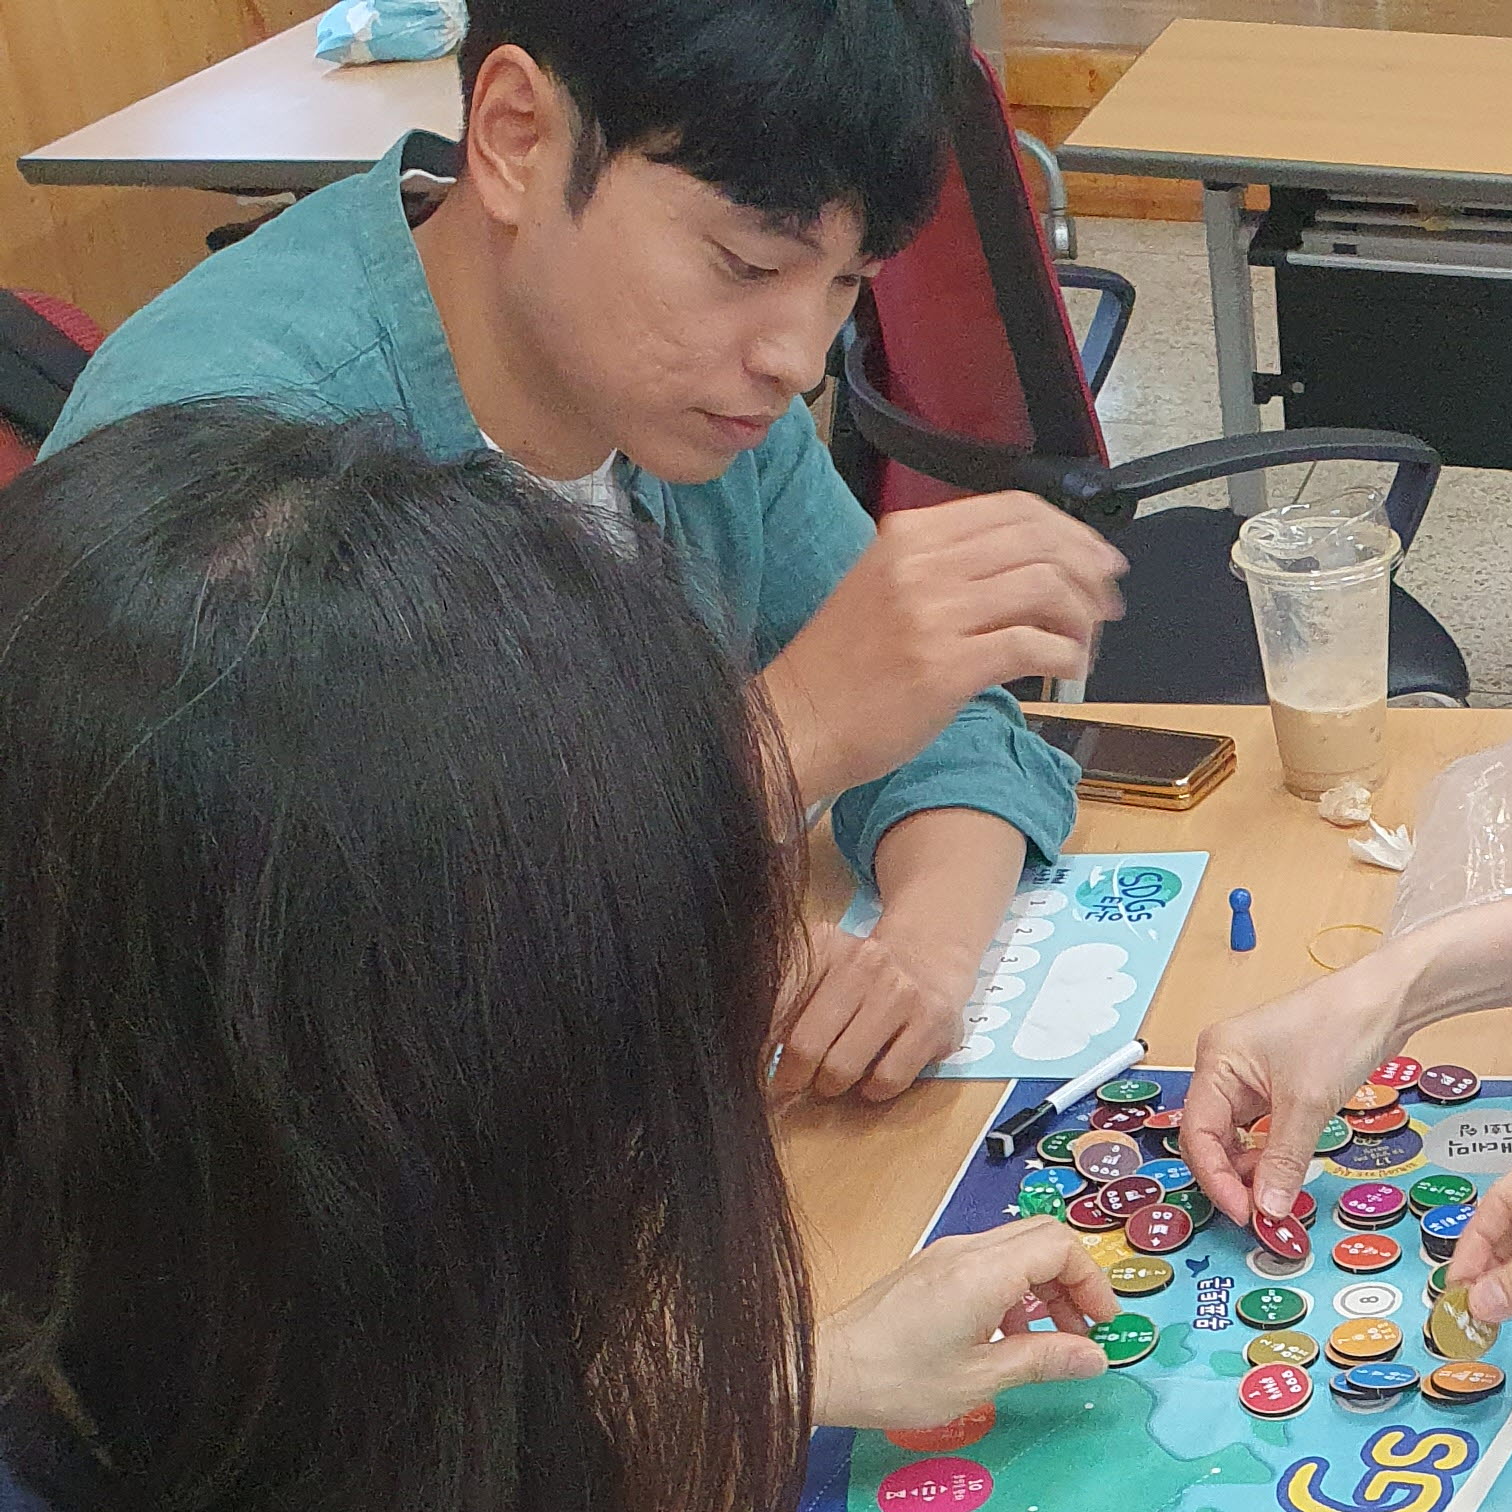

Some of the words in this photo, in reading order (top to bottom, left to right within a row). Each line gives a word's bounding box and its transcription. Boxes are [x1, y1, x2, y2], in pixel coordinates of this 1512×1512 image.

[1118, 872, 1166, 922] SDGs
[1085, 896, 1123, 922] 타운
[985, 985, 1003, 993] 4
[1194, 1276, 1235, 1331] 목표토큰
[1360, 1296, 1378, 1304] 8
[968, 1478, 984, 1491] 10
